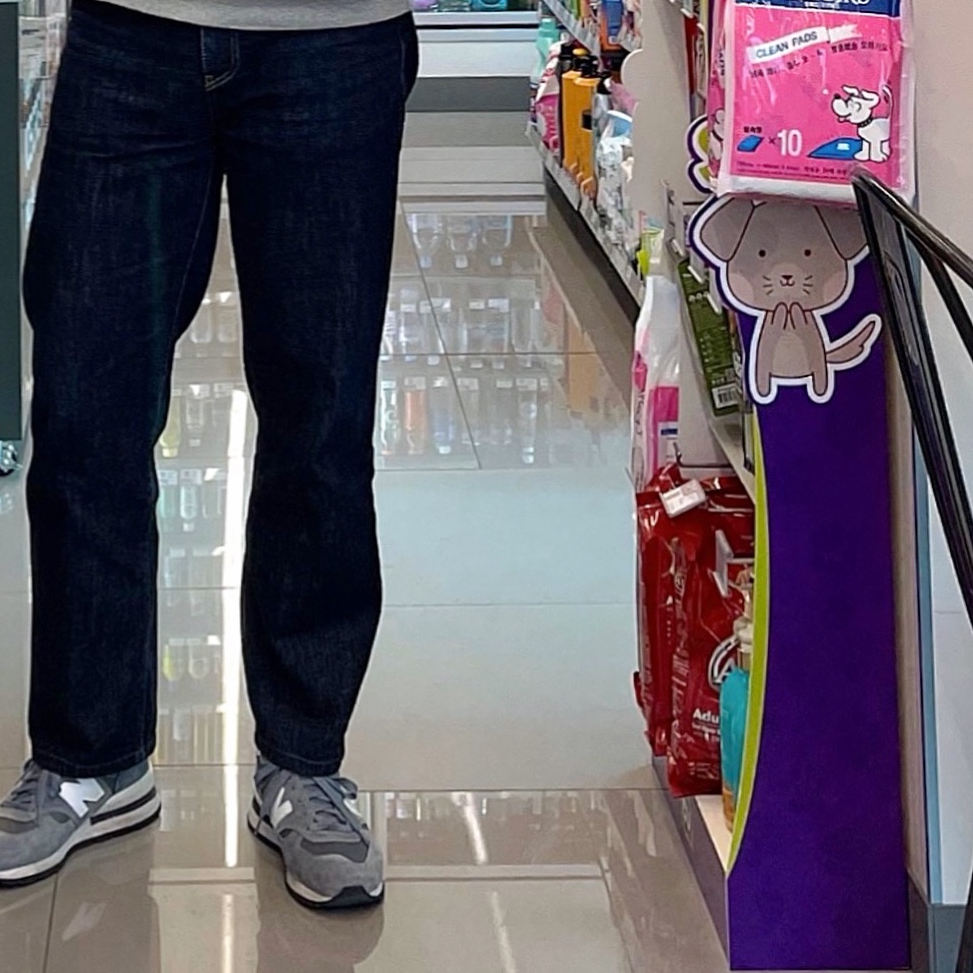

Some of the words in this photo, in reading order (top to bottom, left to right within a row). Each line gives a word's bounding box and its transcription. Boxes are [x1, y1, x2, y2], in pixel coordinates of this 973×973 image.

[756, 37, 790, 61] CLEAN
[791, 30, 819, 50] PADS
[693, 708, 719, 724] Adu
